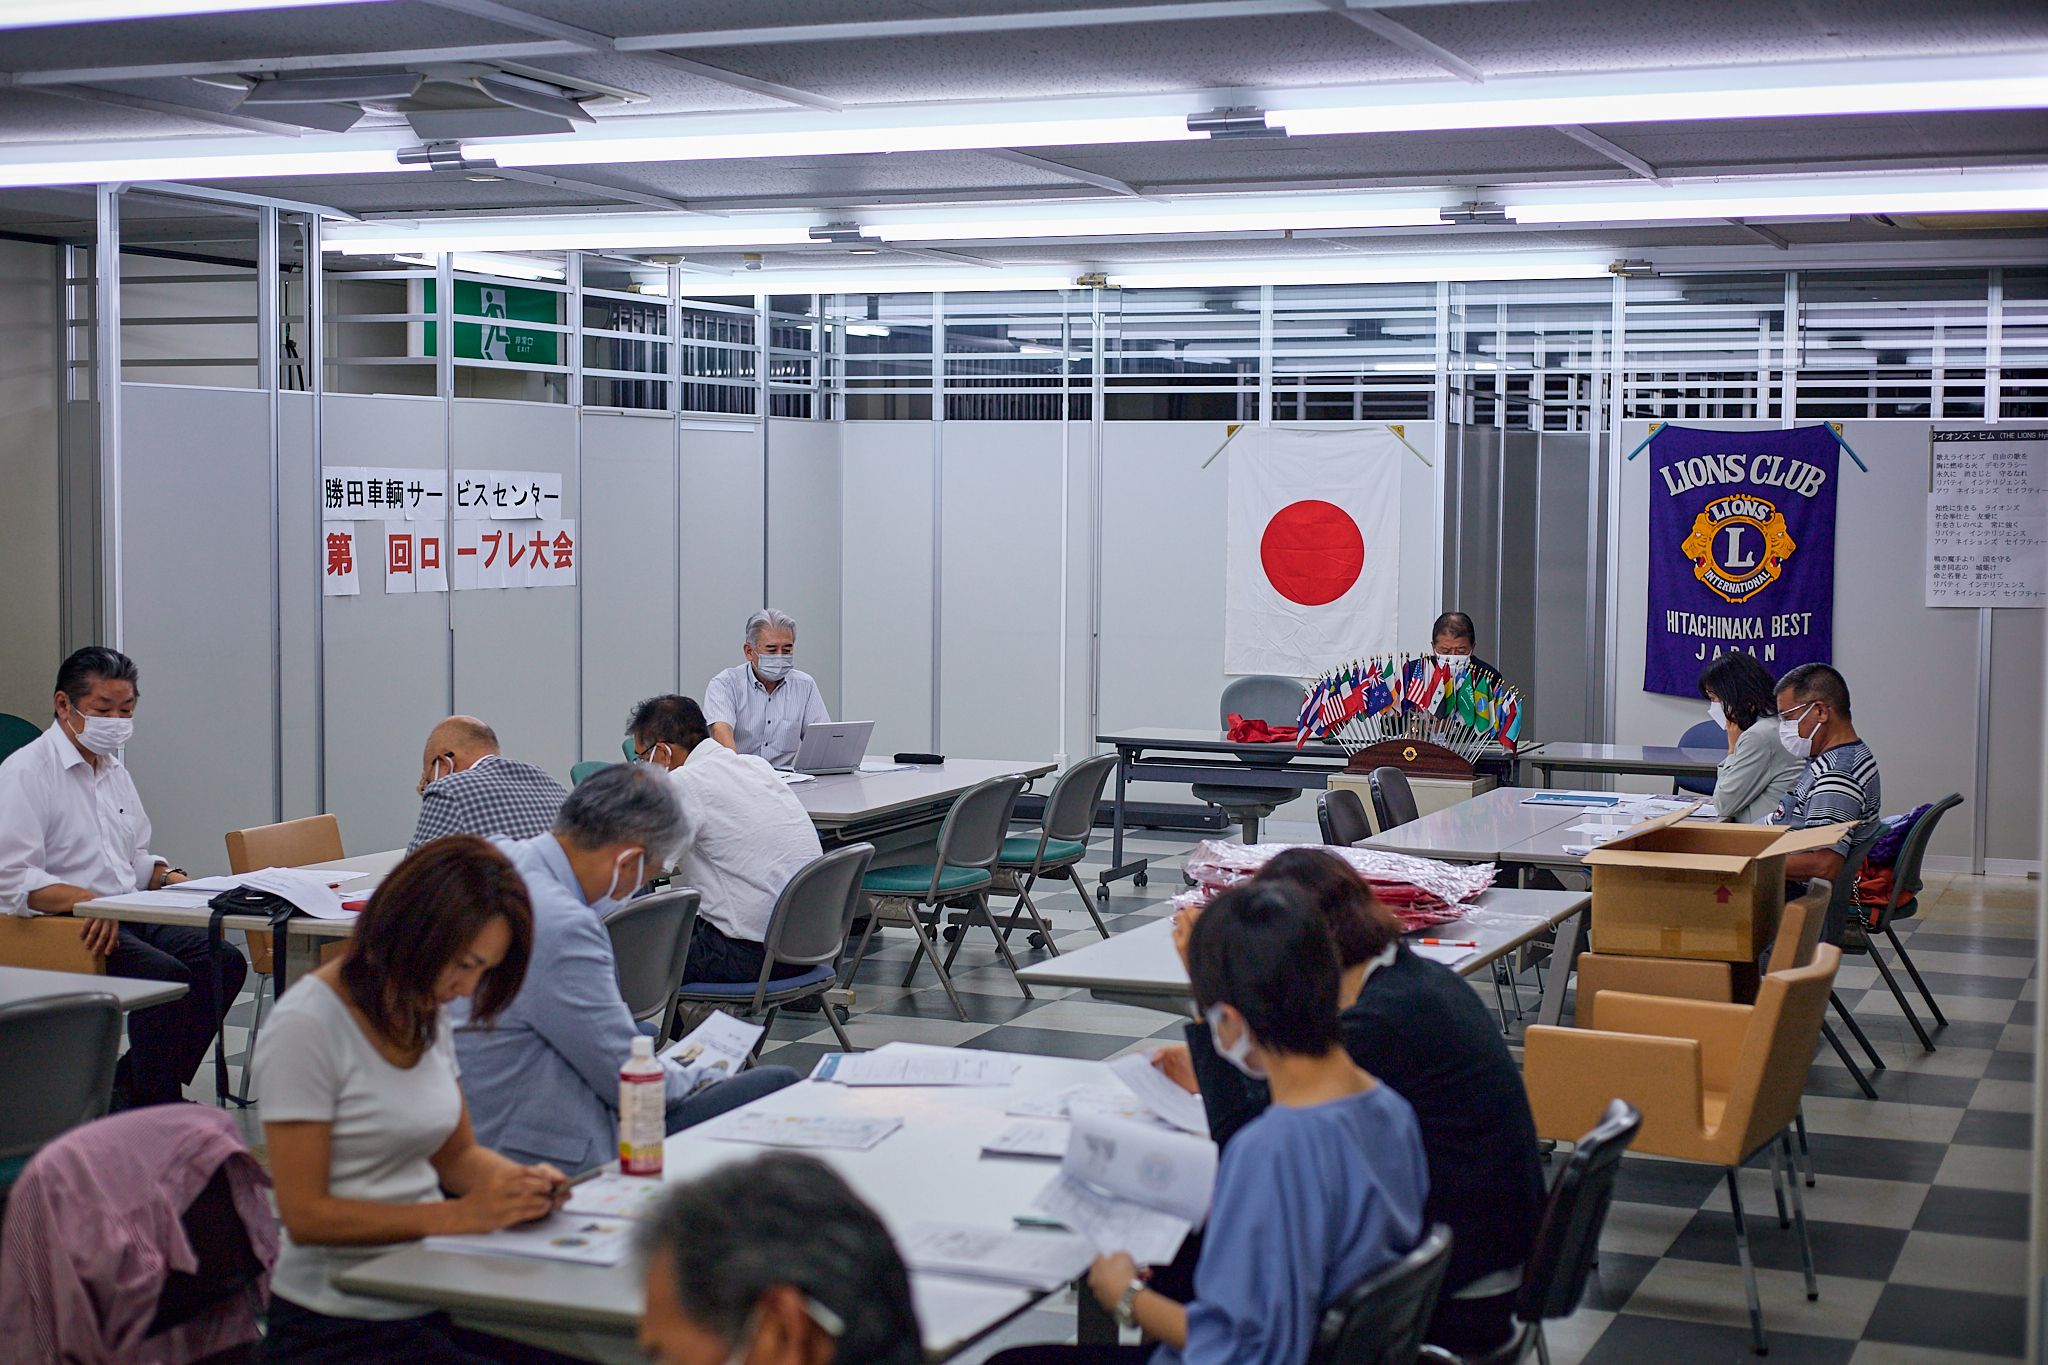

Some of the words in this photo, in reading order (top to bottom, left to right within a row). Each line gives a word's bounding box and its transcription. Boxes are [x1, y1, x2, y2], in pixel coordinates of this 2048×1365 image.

[515, 336, 533, 345] 非常口
[1659, 454, 1747, 496] LIONS
[1750, 454, 1826, 497] CLUB
[1710, 500, 1770, 521] LIONS
[326, 532, 353, 576] 第
[1724, 527, 1755, 568] L
[1704, 569, 1771, 594] INTERNATIONAL
[1667, 610, 1764, 640] HITACHINAKA
[1771, 612, 1812, 639] BEST
